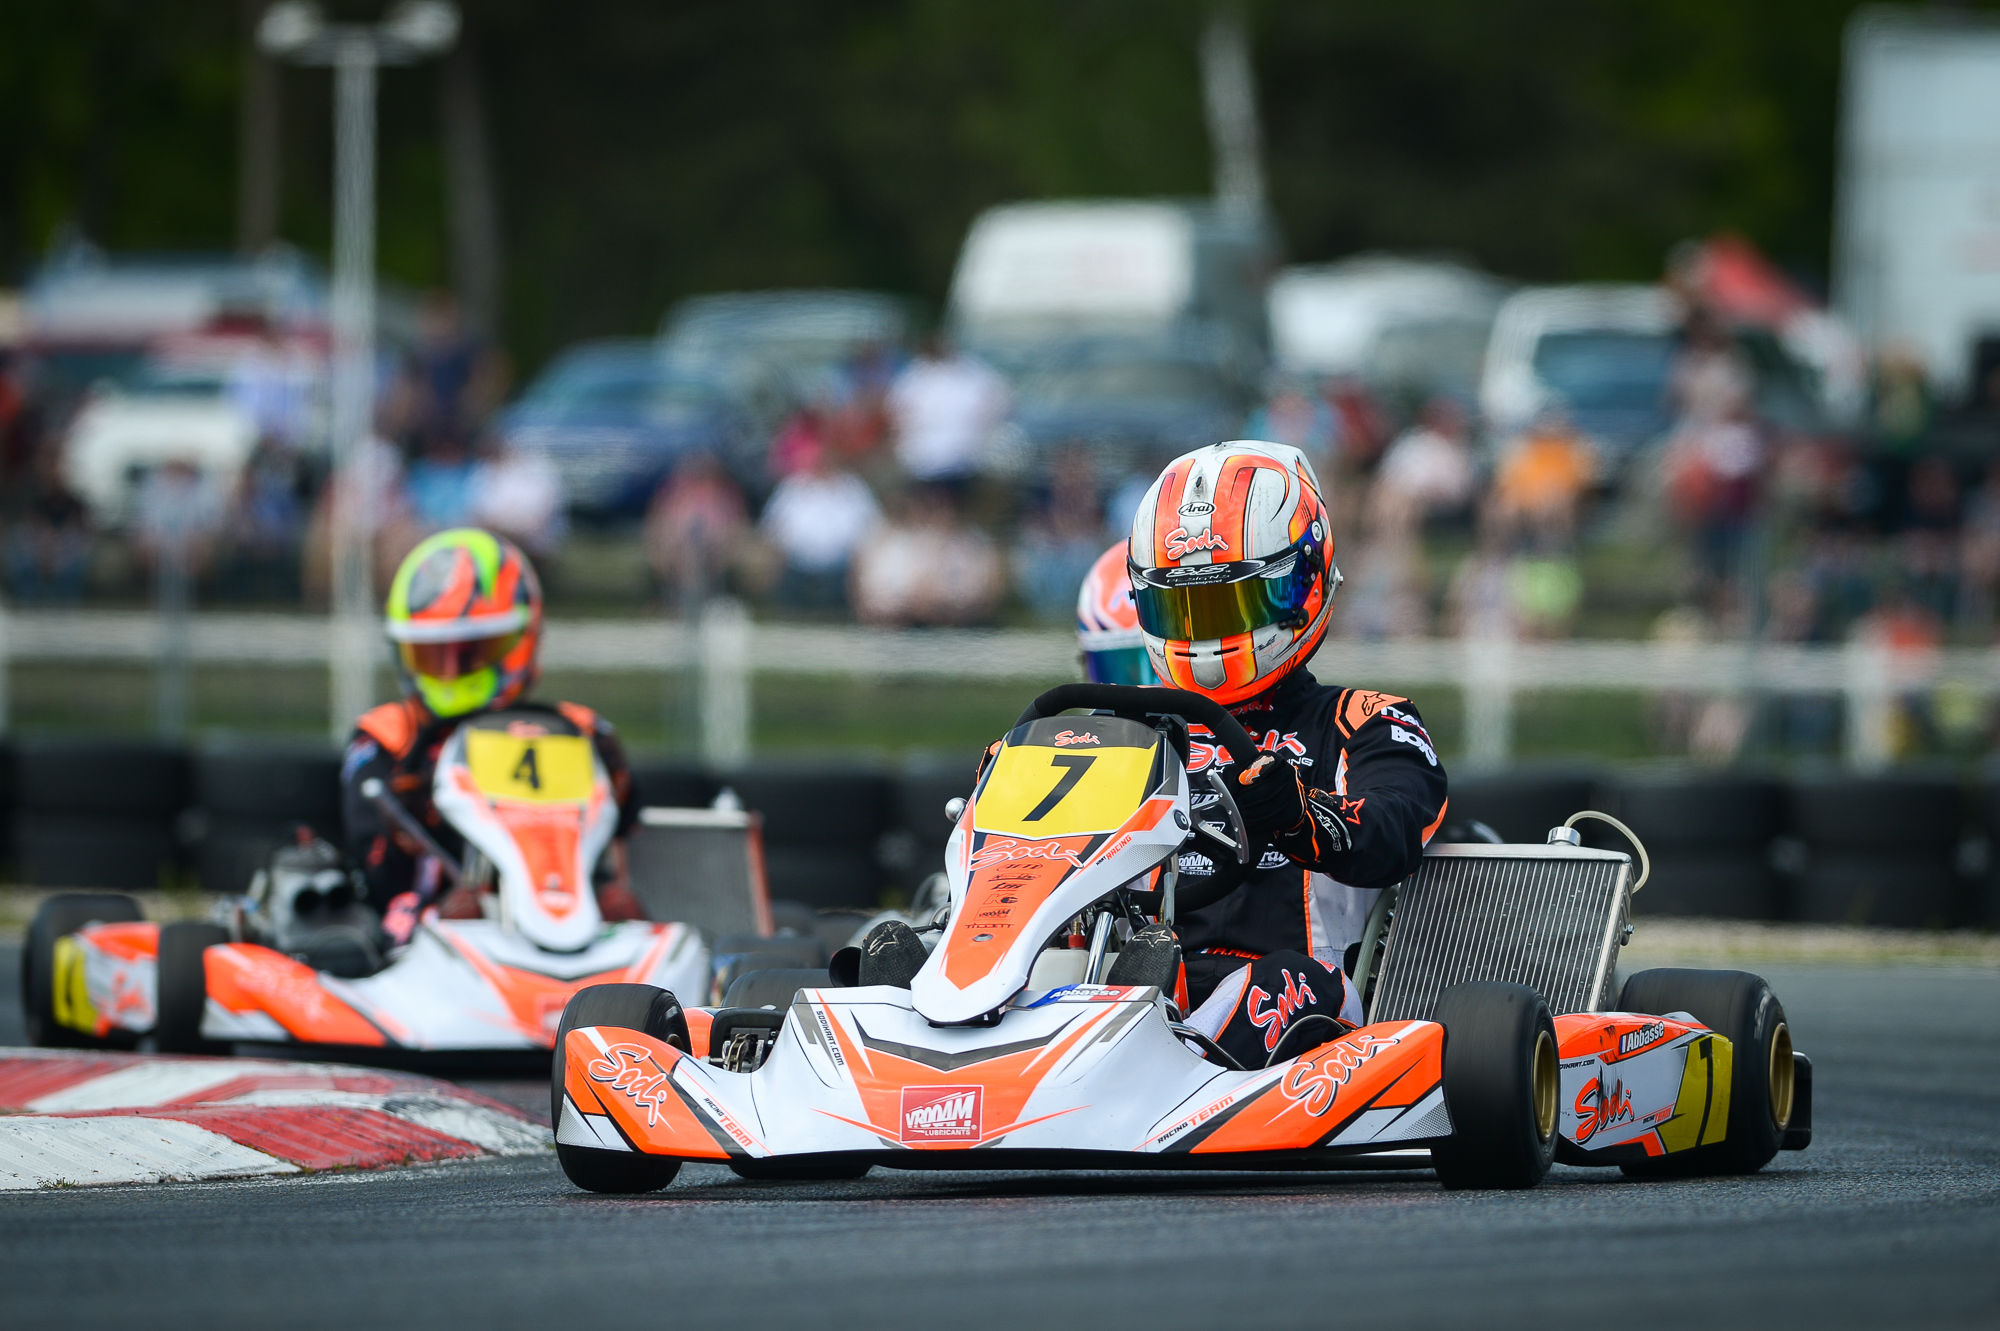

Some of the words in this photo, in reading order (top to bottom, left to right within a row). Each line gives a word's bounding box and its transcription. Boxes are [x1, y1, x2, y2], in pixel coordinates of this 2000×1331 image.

[1181, 503, 1211, 513] Arai
[1164, 527, 1229, 560] Sodi
[1055, 730, 1100, 747] Sodi
[512, 746, 541, 790] 4
[1021, 754, 1098, 822] 7
[969, 839, 1085, 872] Sodi
[1105, 834, 1132, 860] RACING
[1048, 988, 1121, 999] Abbasse
[1247, 969, 1317, 1052] Sodi
[816, 1010, 845, 1067] SODIKART.COM
[1626, 1022, 1664, 1052] Abbasse
[588, 1043, 667, 1128] Sodi
[1280, 1035, 1401, 1117] Sodi
[704, 1098, 725, 1117] RACING
[720, 1115, 753, 1147] TEAM
[905, 1093, 976, 1129] VROOAM
[1157, 1121, 1188, 1144] RACING
[1188, 1095, 1234, 1126] TEAM
[1574, 1077, 1634, 1145] Sodi
